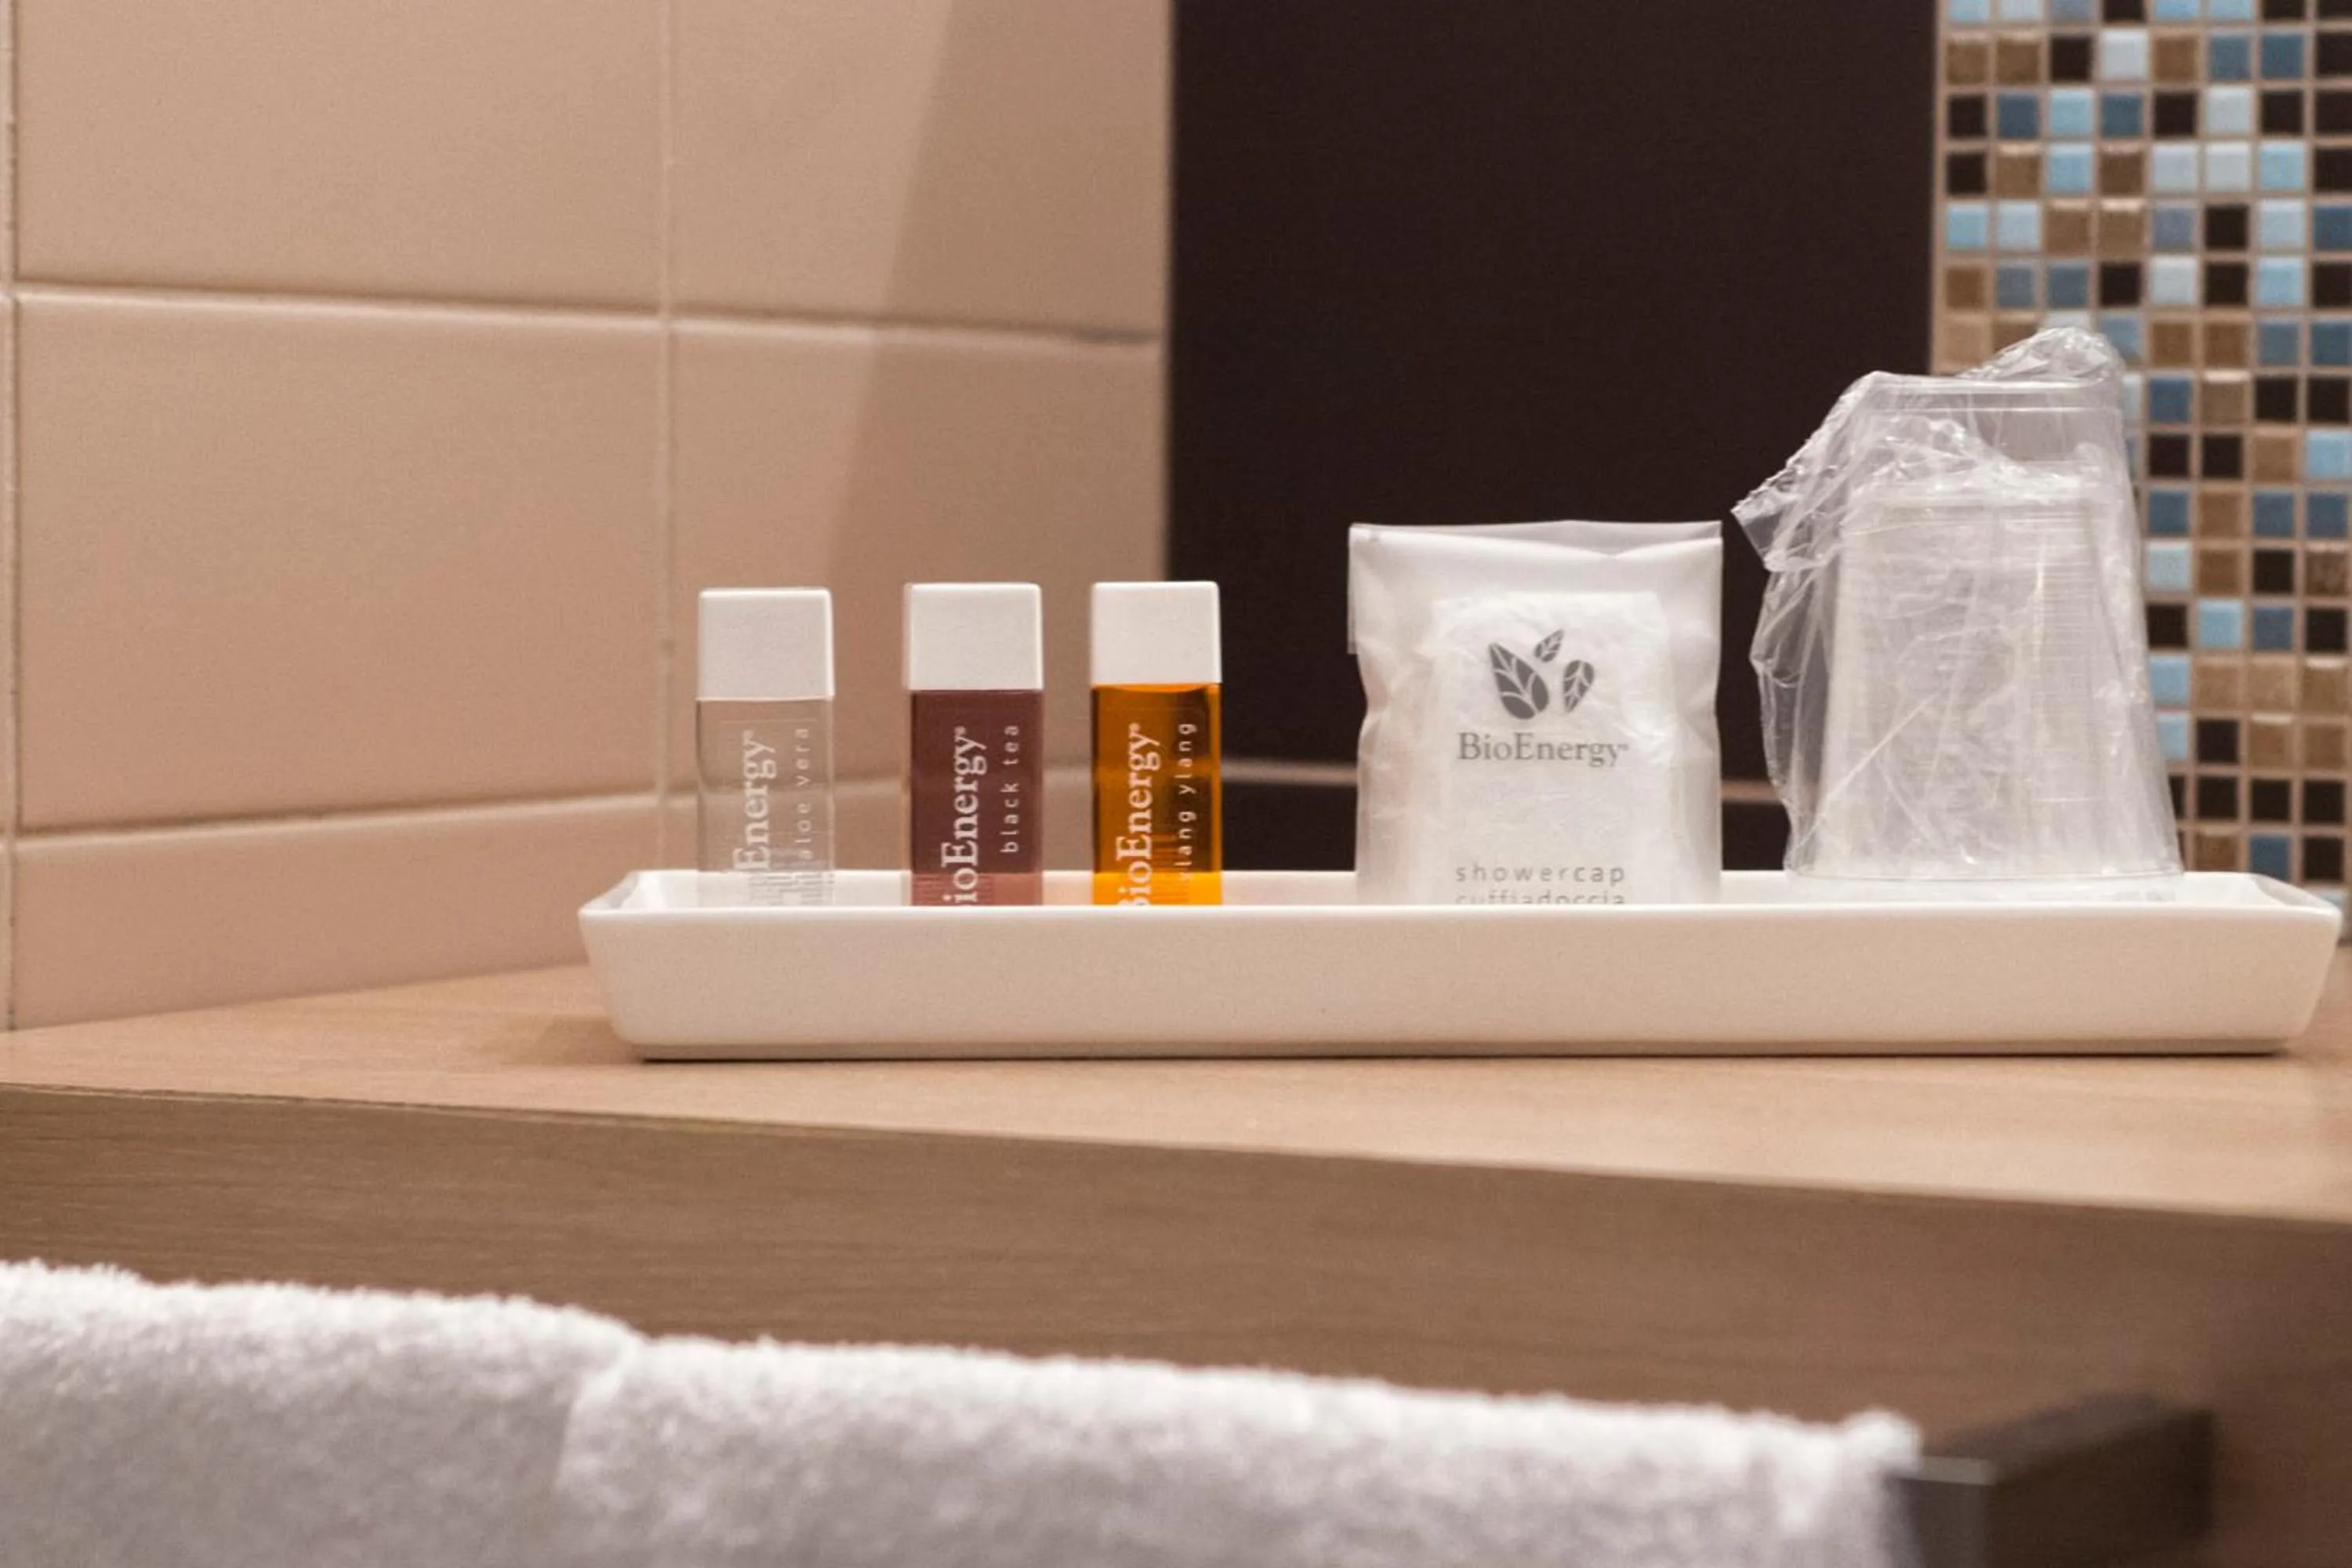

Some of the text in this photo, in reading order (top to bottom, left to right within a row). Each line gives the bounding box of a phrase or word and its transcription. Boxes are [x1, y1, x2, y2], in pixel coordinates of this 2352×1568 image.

[731, 739, 776, 872] Energy
[794, 728, 813, 860] aloe vera
[942, 734, 987, 904] ioEnergy
[1000, 725, 1019, 853] black tea
[1174, 723, 1197, 795] ylang
[1455, 862, 1625, 886] showercap
